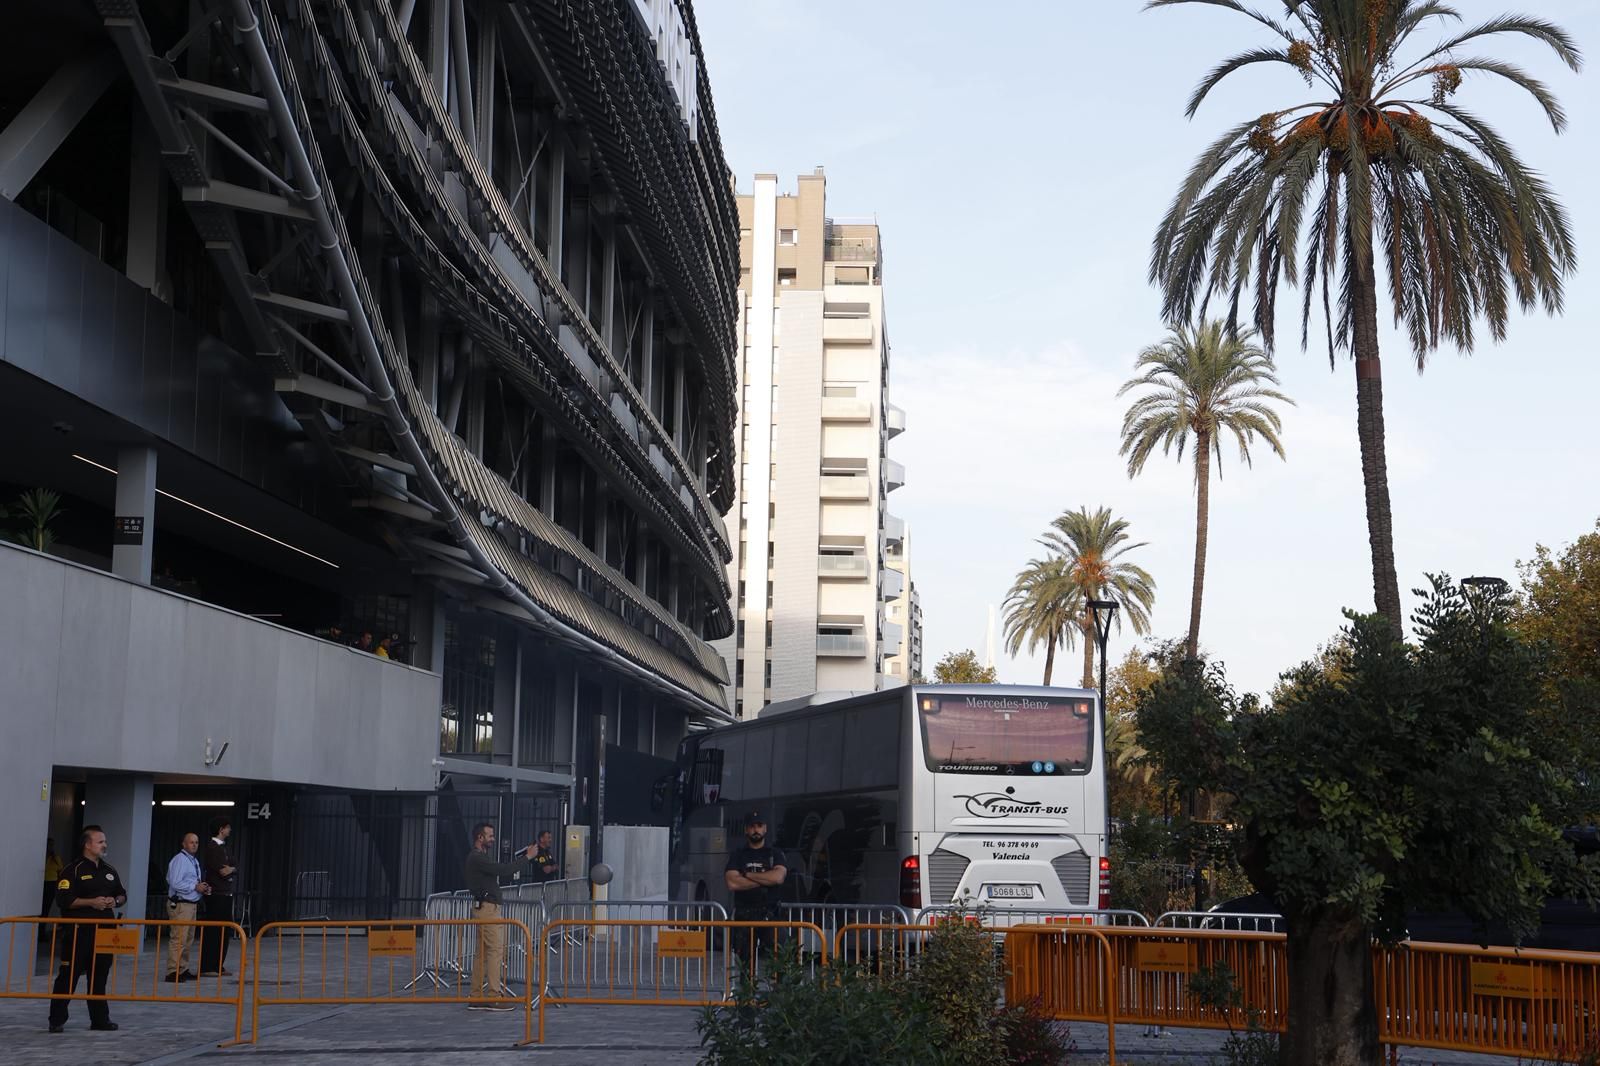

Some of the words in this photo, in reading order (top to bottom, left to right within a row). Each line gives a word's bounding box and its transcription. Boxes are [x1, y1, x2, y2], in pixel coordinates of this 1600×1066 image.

[966, 697, 1049, 710] Mercedes-Benz
[247, 802, 272, 819] E4
[991, 805, 1069, 814] TRANSIT-BUS
[1030, 841, 1039, 849] 69
[993, 852, 1030, 860] Valencia
